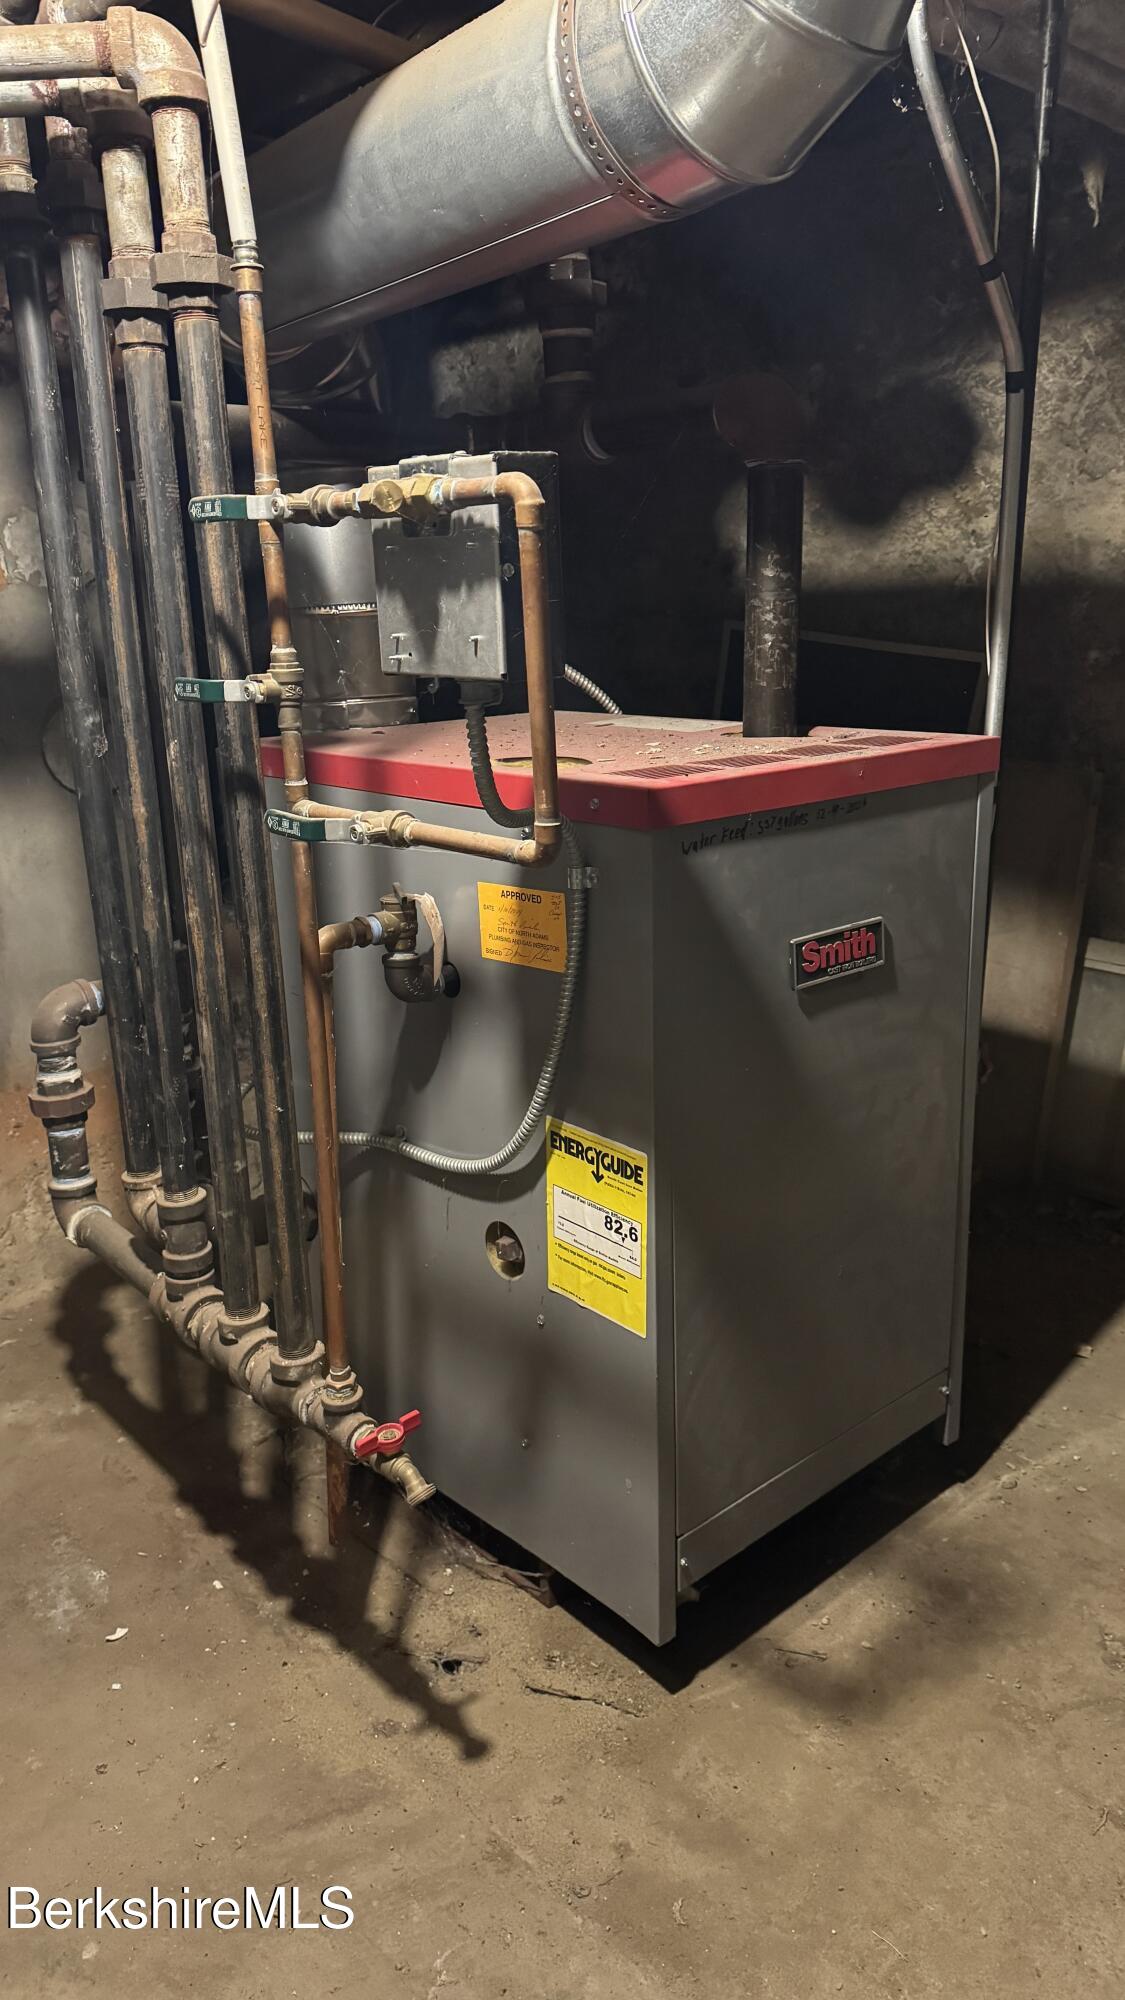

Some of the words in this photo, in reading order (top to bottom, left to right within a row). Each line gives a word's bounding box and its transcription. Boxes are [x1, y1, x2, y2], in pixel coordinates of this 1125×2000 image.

[501, 890, 542, 904] APPROVED
[489, 933, 511, 943] PLUMBING
[533, 942, 560, 952] INSPECTOR
[516, 930, 532, 938] NORTH
[486, 947, 502, 956] SIGNED
[802, 927, 876, 973] Smith
[550, 1131, 644, 1186] ENERGYGUIDE
[561, 1190, 577, 1200] Annual
[577, 1197, 586, 1205] Fuel
[587, 1201, 610, 1215] Utilization
[611, 1212, 634, 1226] Efficiency
[604, 1215, 638, 1243] 82.6
